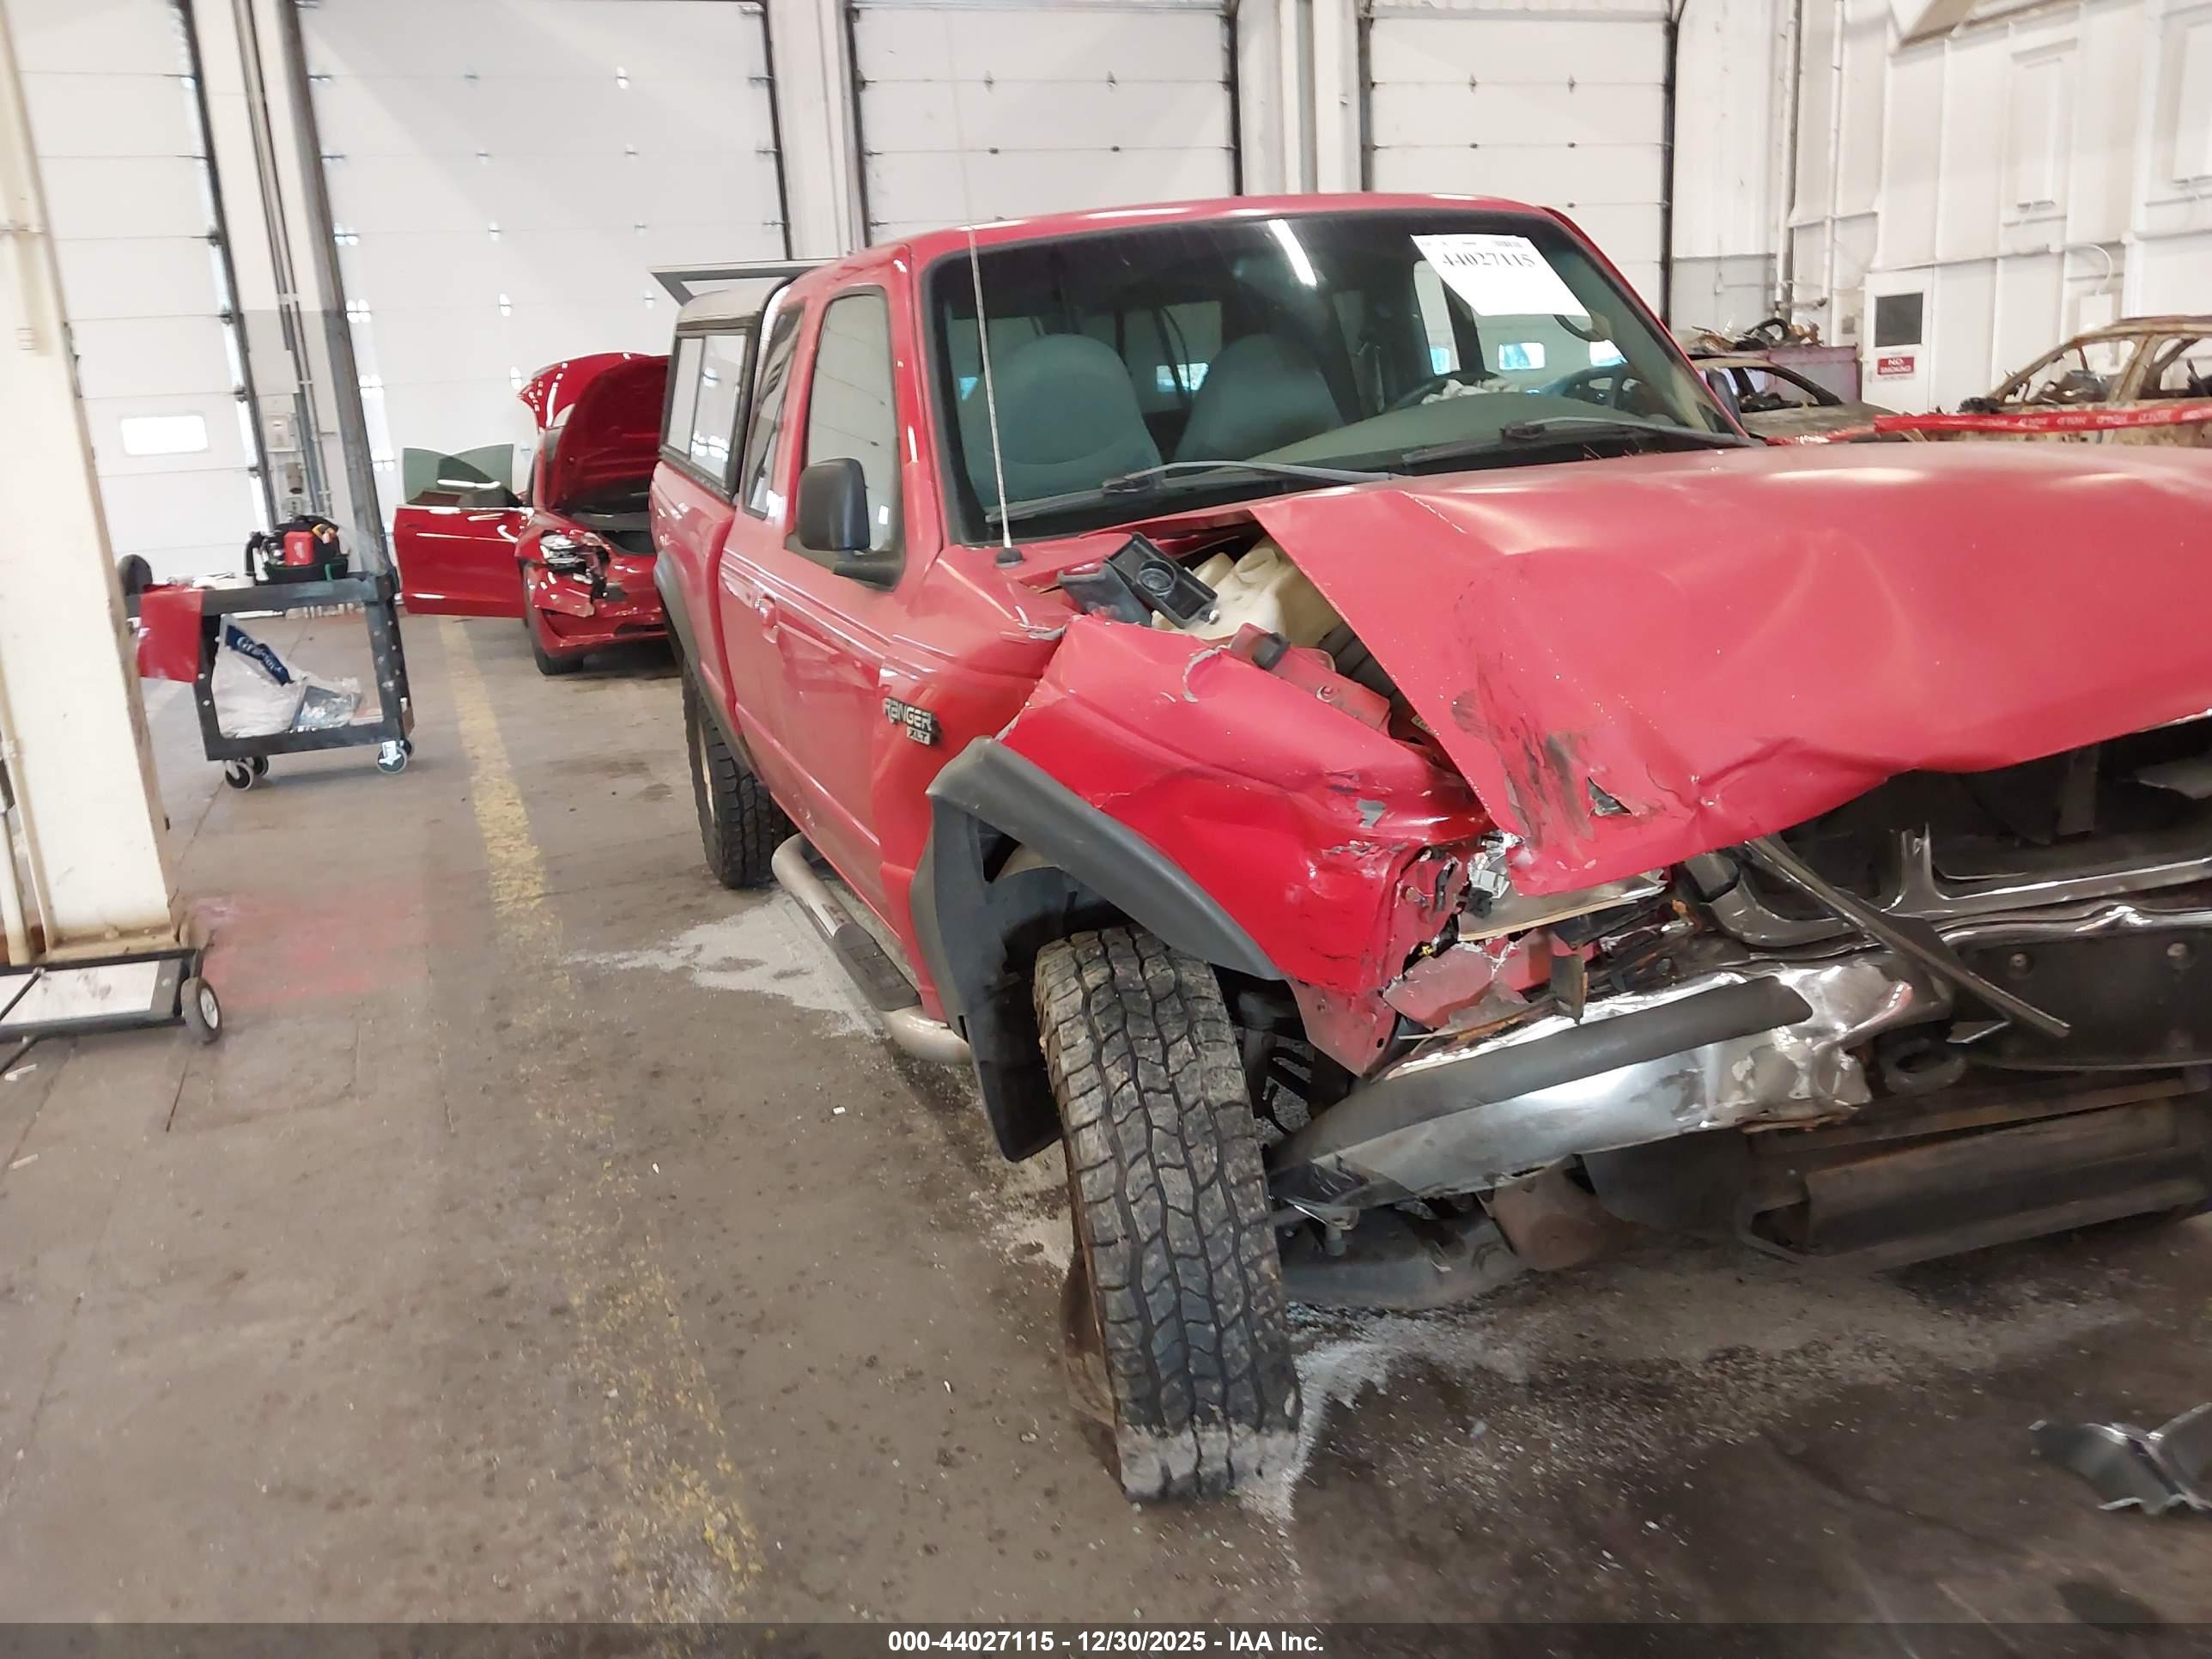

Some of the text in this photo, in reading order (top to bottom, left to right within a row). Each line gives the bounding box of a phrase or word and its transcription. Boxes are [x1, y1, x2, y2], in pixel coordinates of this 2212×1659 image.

[1443, 252, 1535, 268] 44027115
[1888, 357, 1904, 366] NO
[883, 696, 933, 732] RANGER
[908, 728, 928, 743] XLT
